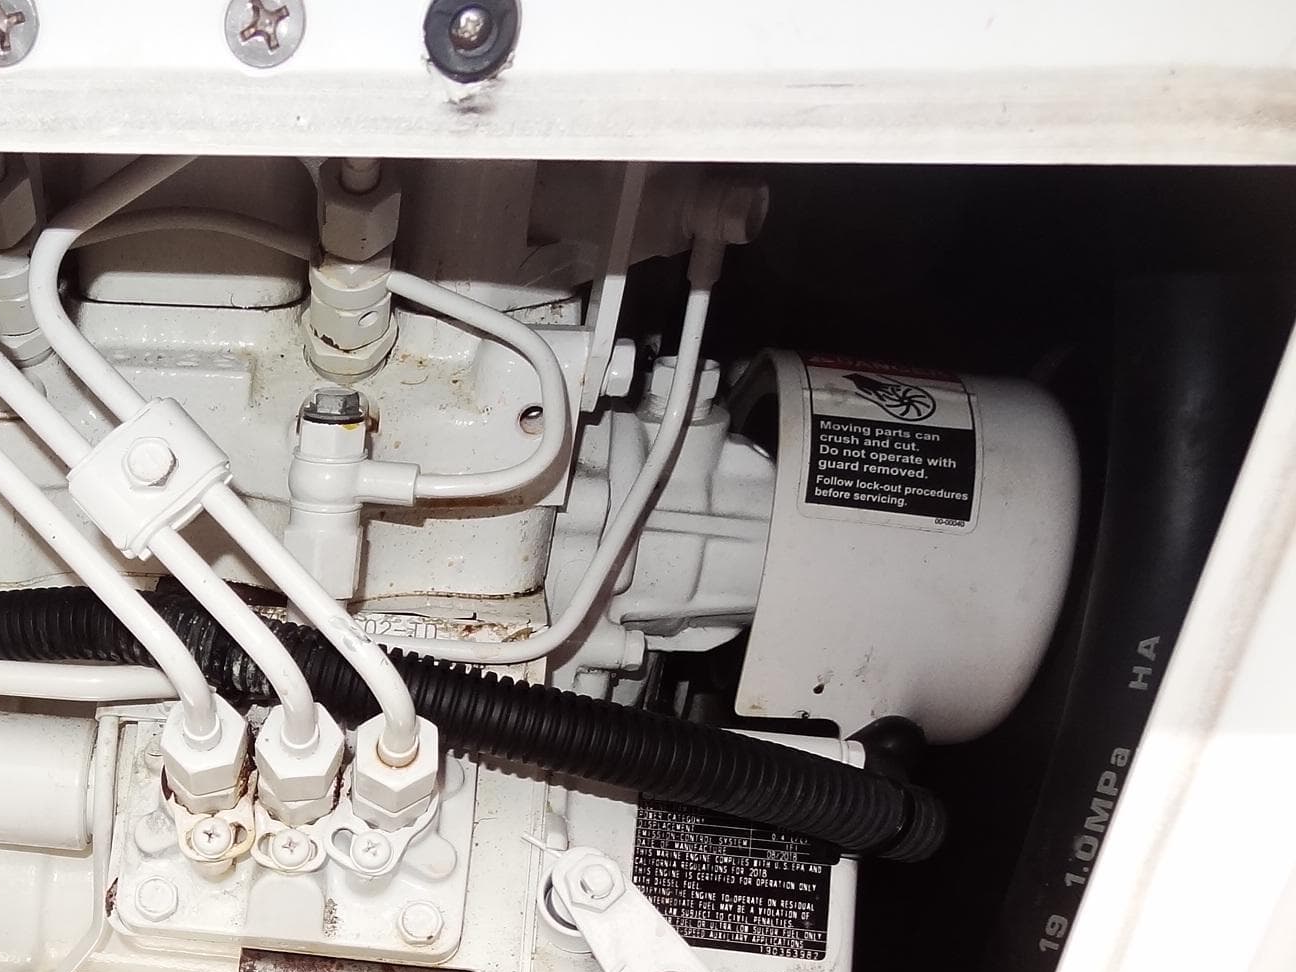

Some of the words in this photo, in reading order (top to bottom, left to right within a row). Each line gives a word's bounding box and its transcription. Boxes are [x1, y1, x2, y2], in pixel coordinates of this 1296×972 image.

[820, 420, 871, 436] Moving
[875, 427, 911, 439] parts
[915, 432, 940, 442] can
[820, 433, 859, 445] crush
[863, 436, 890, 448] and
[894, 441, 920, 452] cut.
[819, 444, 838, 456] Do
[843, 447, 866, 459] not
[870, 451, 923, 465] operate
[927, 457, 956, 469] with
[818, 459, 859, 472] guard
[863, 464, 928, 479] removed.
[815, 487, 851, 500] before
[853, 492, 908, 508] servicing.
[816, 475, 853, 488] Follow
[856, 479, 902, 493] lock-out
[904, 486, 969, 501] procedures
[1039, 913, 1069, 952] 19
[1065, 746, 1131, 888] 1.0MPa
[634, 856, 676, 868] CALIFORNIA
[681, 861, 728, 874] REGULATIONS
[731, 866, 745, 875] FOR
[748, 867, 768, 879] 2018
[635, 847, 652, 857] THIS
[656, 850, 681, 860] MARINE
[685, 852, 710, 863] ENGINE
[715, 855, 749, 867] COMPLIES
[753, 859, 771, 869] WITH
[808, 864, 822, 874] AND
[634, 865, 651, 875] THIS
[655, 868, 680, 879] ENGINE
[685, 871, 693, 880] IS
[696, 872, 736, 885] CERTIFIED
[739, 876, 752, 885] FOR
[755, 878, 795, 890] OPERATION
[798, 882, 817, 892] ONLY
[654, 877, 679, 888] DIESEL
[648, 895, 694, 908] NTERMEDIATE
[699, 900, 715, 911] FUEL
[720, 903, 733, 912] MAY
[736, 904, 745, 913] BE
[749, 906, 755, 914] A
[758, 907, 798, 919] VIOLATION
[801, 911, 810, 920] OF
[675, 889, 686, 898] THE
[691, 890, 716, 902] ENGINE
[721, 893, 730, 903] TO
[733, 895, 763, 906] OPERATE
[767, 898, 777, 907] ON
[780, 899, 815, 911] RESIDUAL
[681, 908, 710, 919] SUBJECT
[716, 911, 725, 921] TO
[728, 913, 749, 924] CIVIL
[803, 931, 822, 941] ONLY
